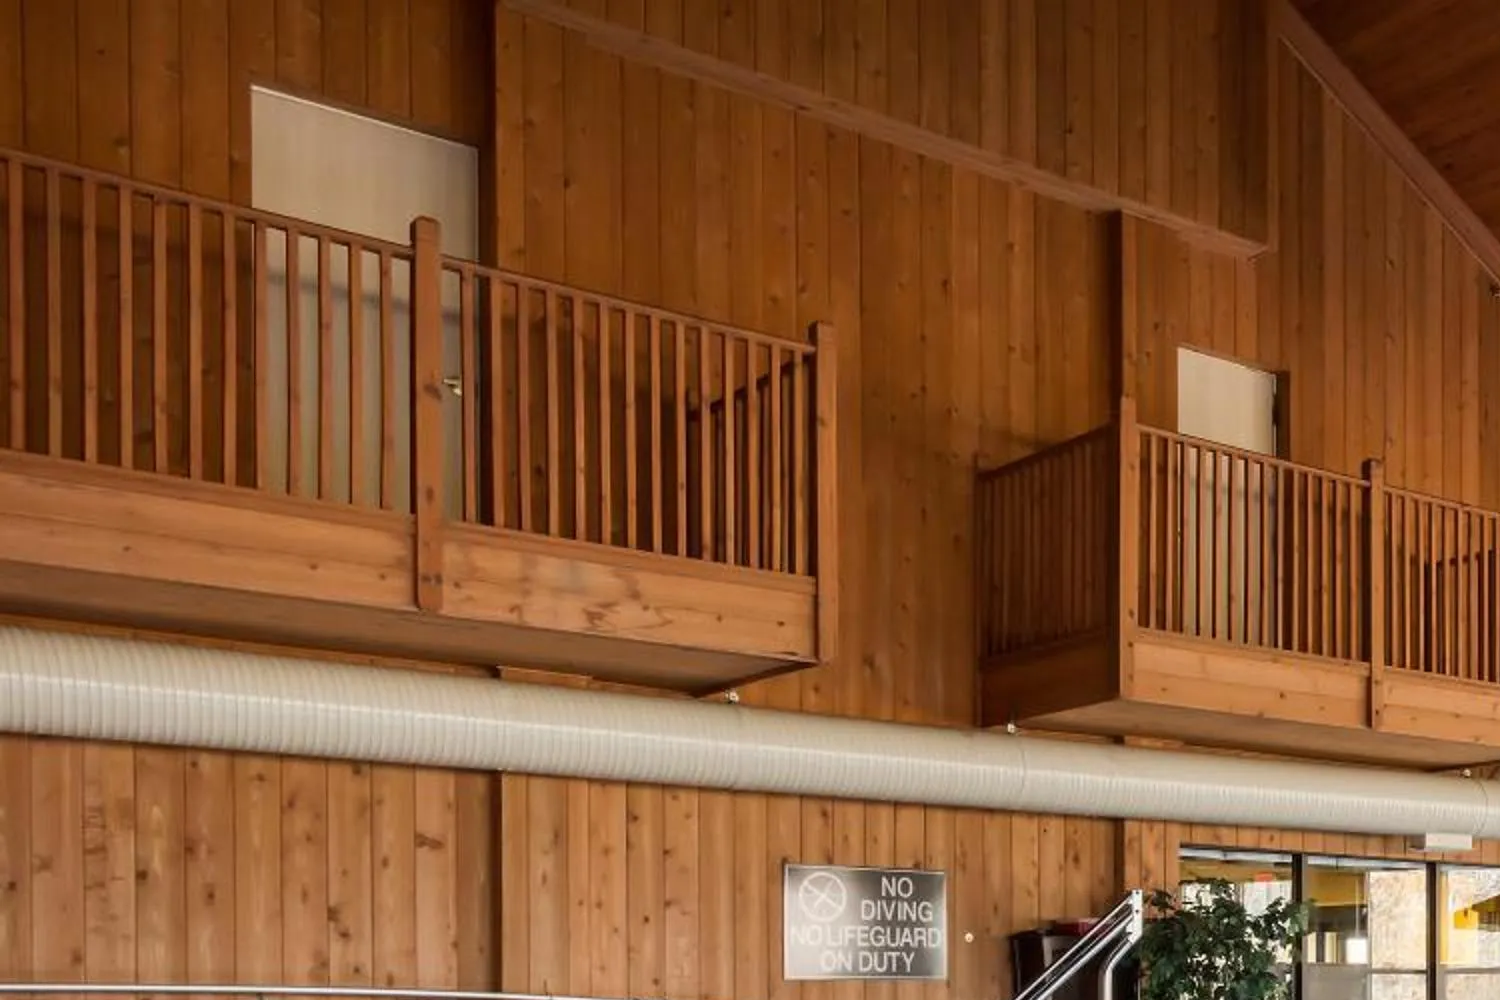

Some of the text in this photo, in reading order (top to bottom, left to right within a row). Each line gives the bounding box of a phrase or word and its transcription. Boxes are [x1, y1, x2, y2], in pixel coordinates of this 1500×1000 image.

[881, 876, 913, 898] NO
[861, 899, 933, 922] DIVING
[791, 924, 942, 947] NO LIFEGUARD
[821, 951, 915, 973] ON DUTY
